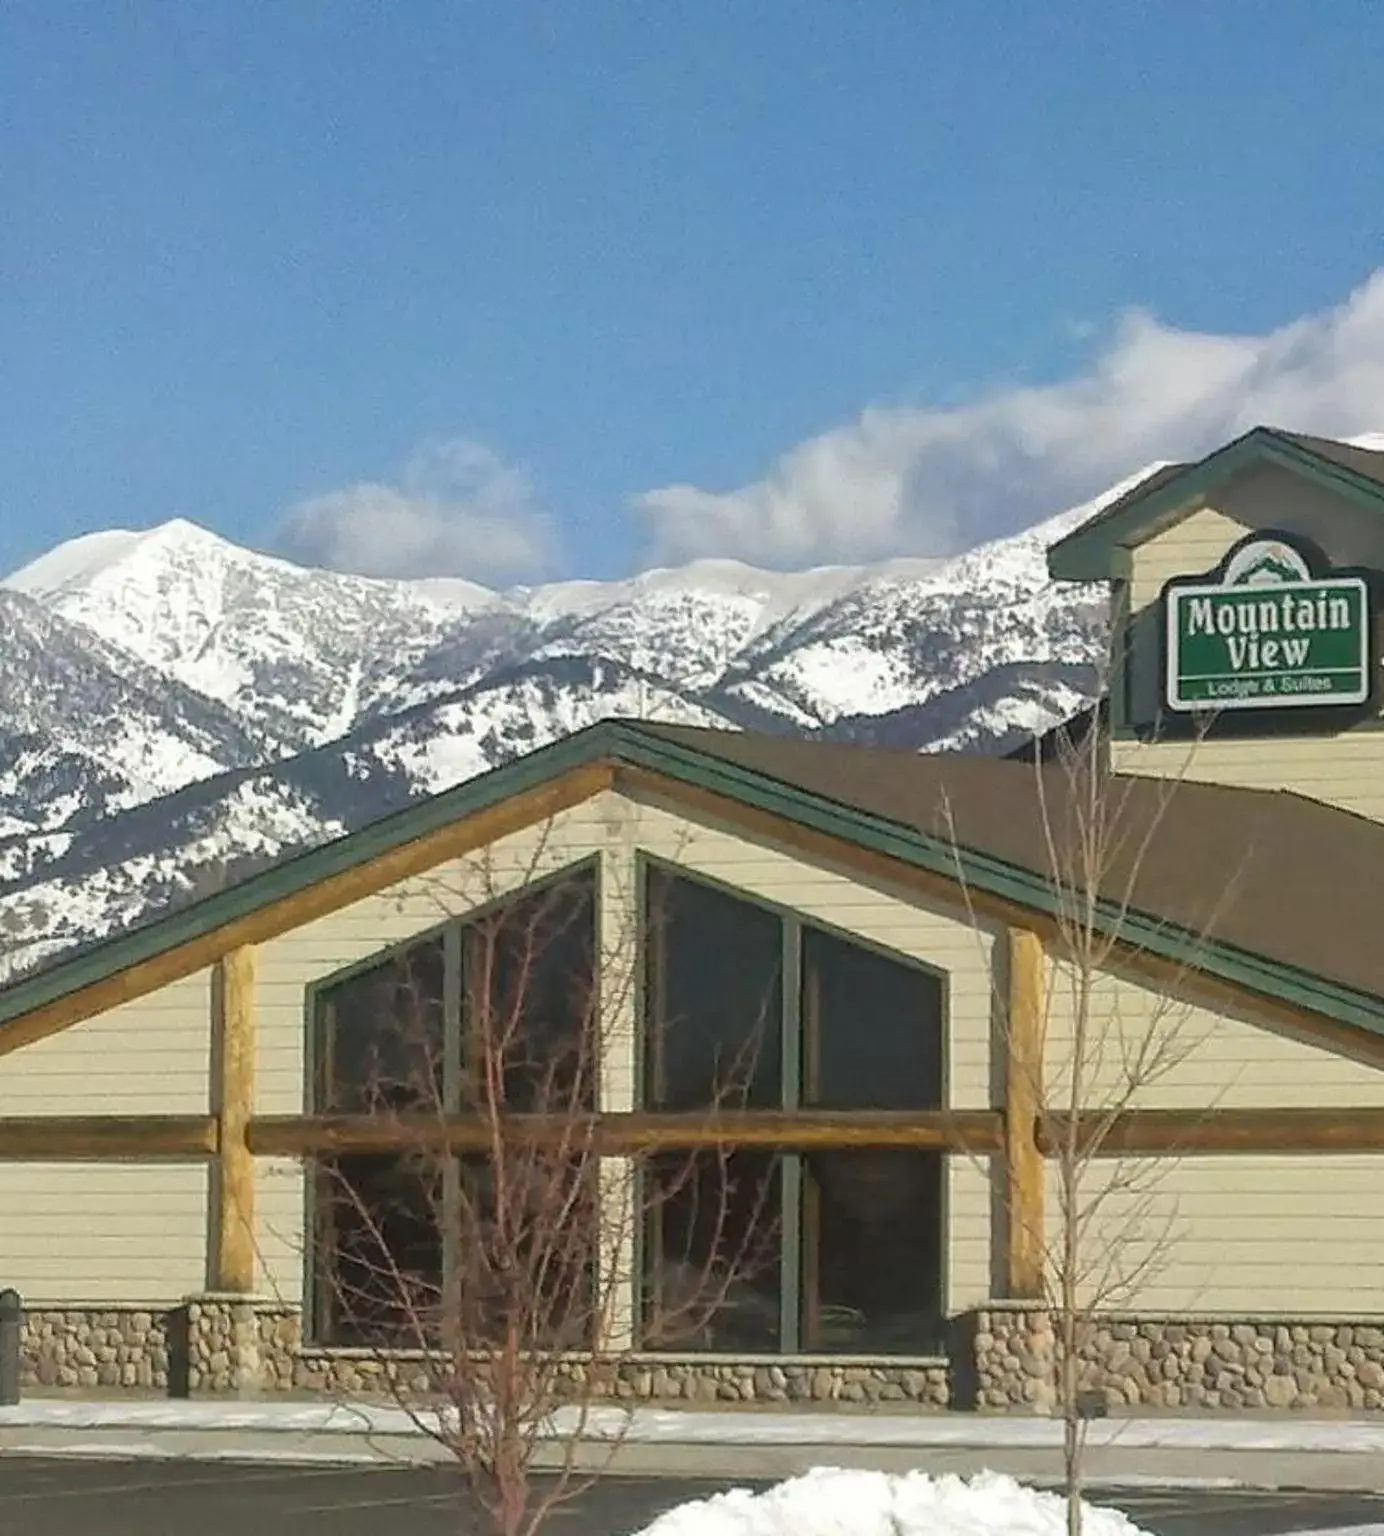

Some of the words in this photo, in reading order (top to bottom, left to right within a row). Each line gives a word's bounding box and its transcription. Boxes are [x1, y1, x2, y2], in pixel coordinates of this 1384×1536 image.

[1187, 590, 1351, 636] Mountain
[1226, 632, 1310, 670] View
[1208, 679, 1259, 699] Lodge
[1262, 679, 1276, 693] &
[1281, 675, 1333, 692] Suites
